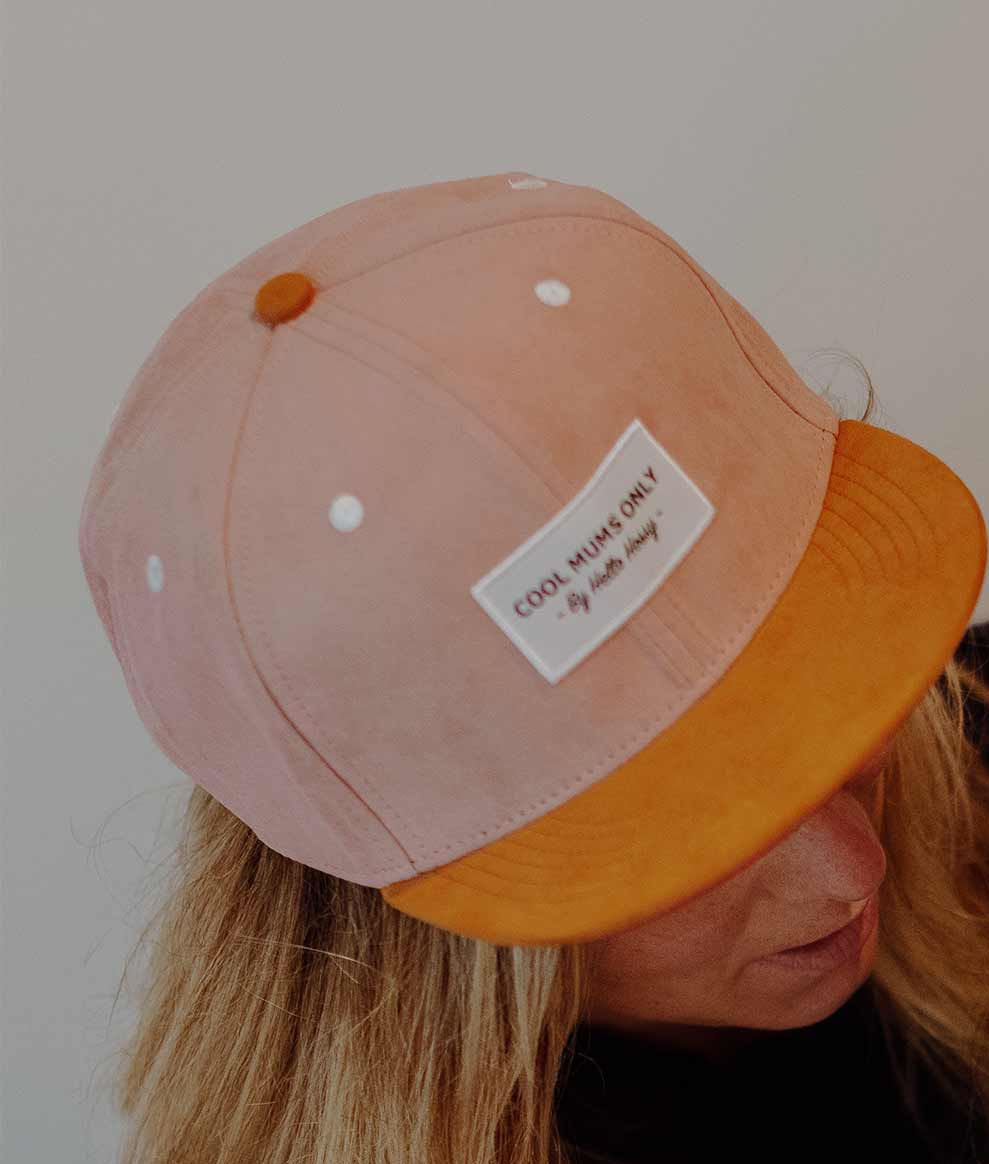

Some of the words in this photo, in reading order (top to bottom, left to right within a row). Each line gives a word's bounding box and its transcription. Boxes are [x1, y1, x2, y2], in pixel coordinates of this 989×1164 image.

[513, 571, 570, 618] COOL
[567, 516, 623, 573] MUMS
[618, 466, 659, 519] ONLY
